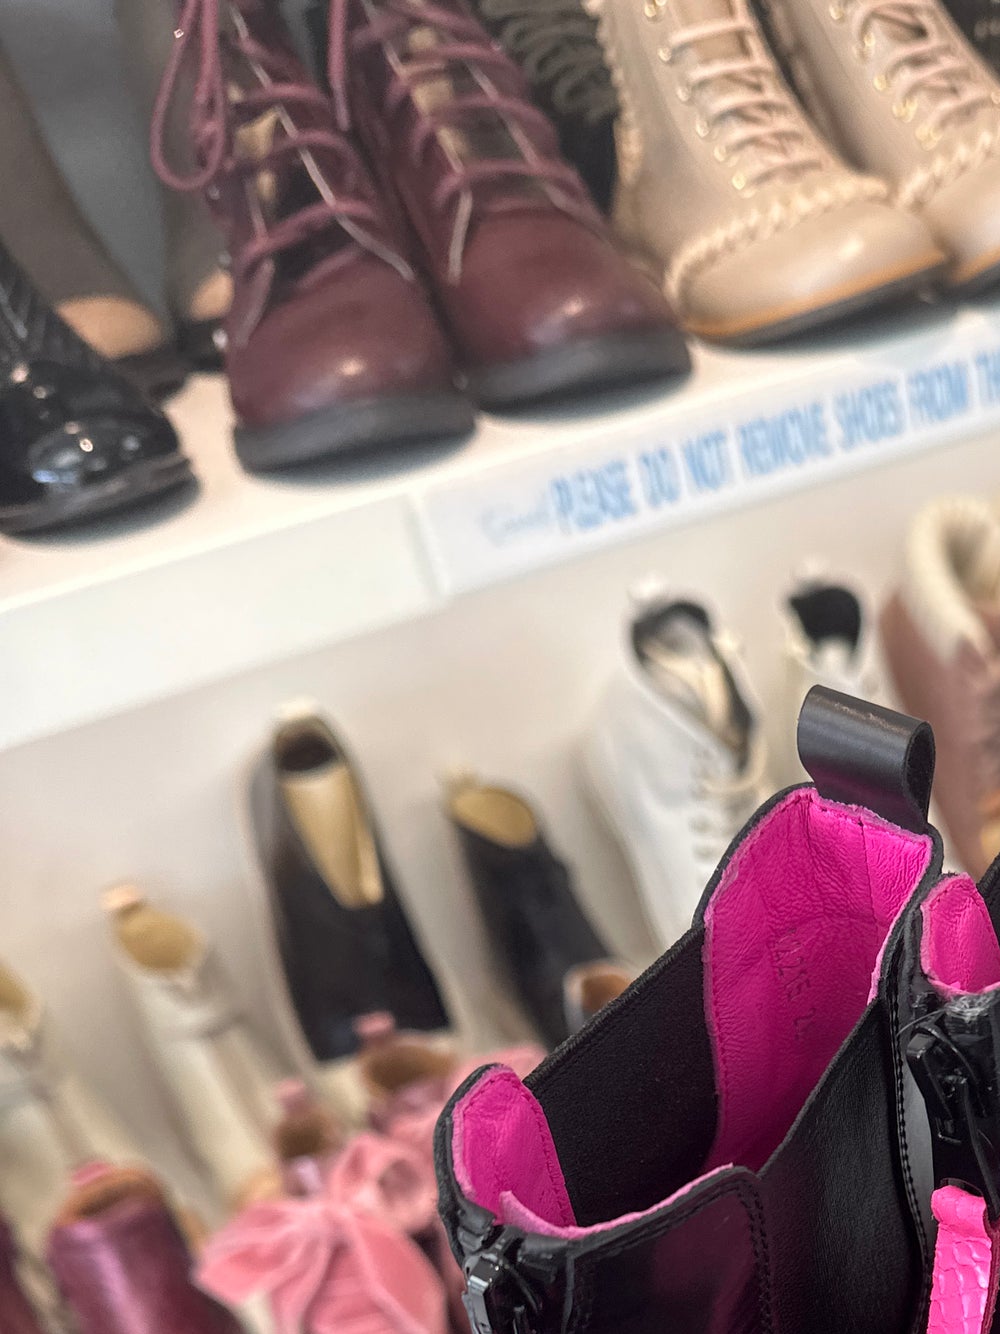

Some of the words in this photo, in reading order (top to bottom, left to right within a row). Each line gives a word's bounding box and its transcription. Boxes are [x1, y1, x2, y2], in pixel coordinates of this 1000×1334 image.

[551, 458, 638, 534] PLEASE
[638, 447, 683, 508] DO
[684, 429, 731, 492] NOT
[738, 400, 833, 476] REMOVE
[833, 380, 907, 450] SHOES
[905, 360, 969, 427] FROM
